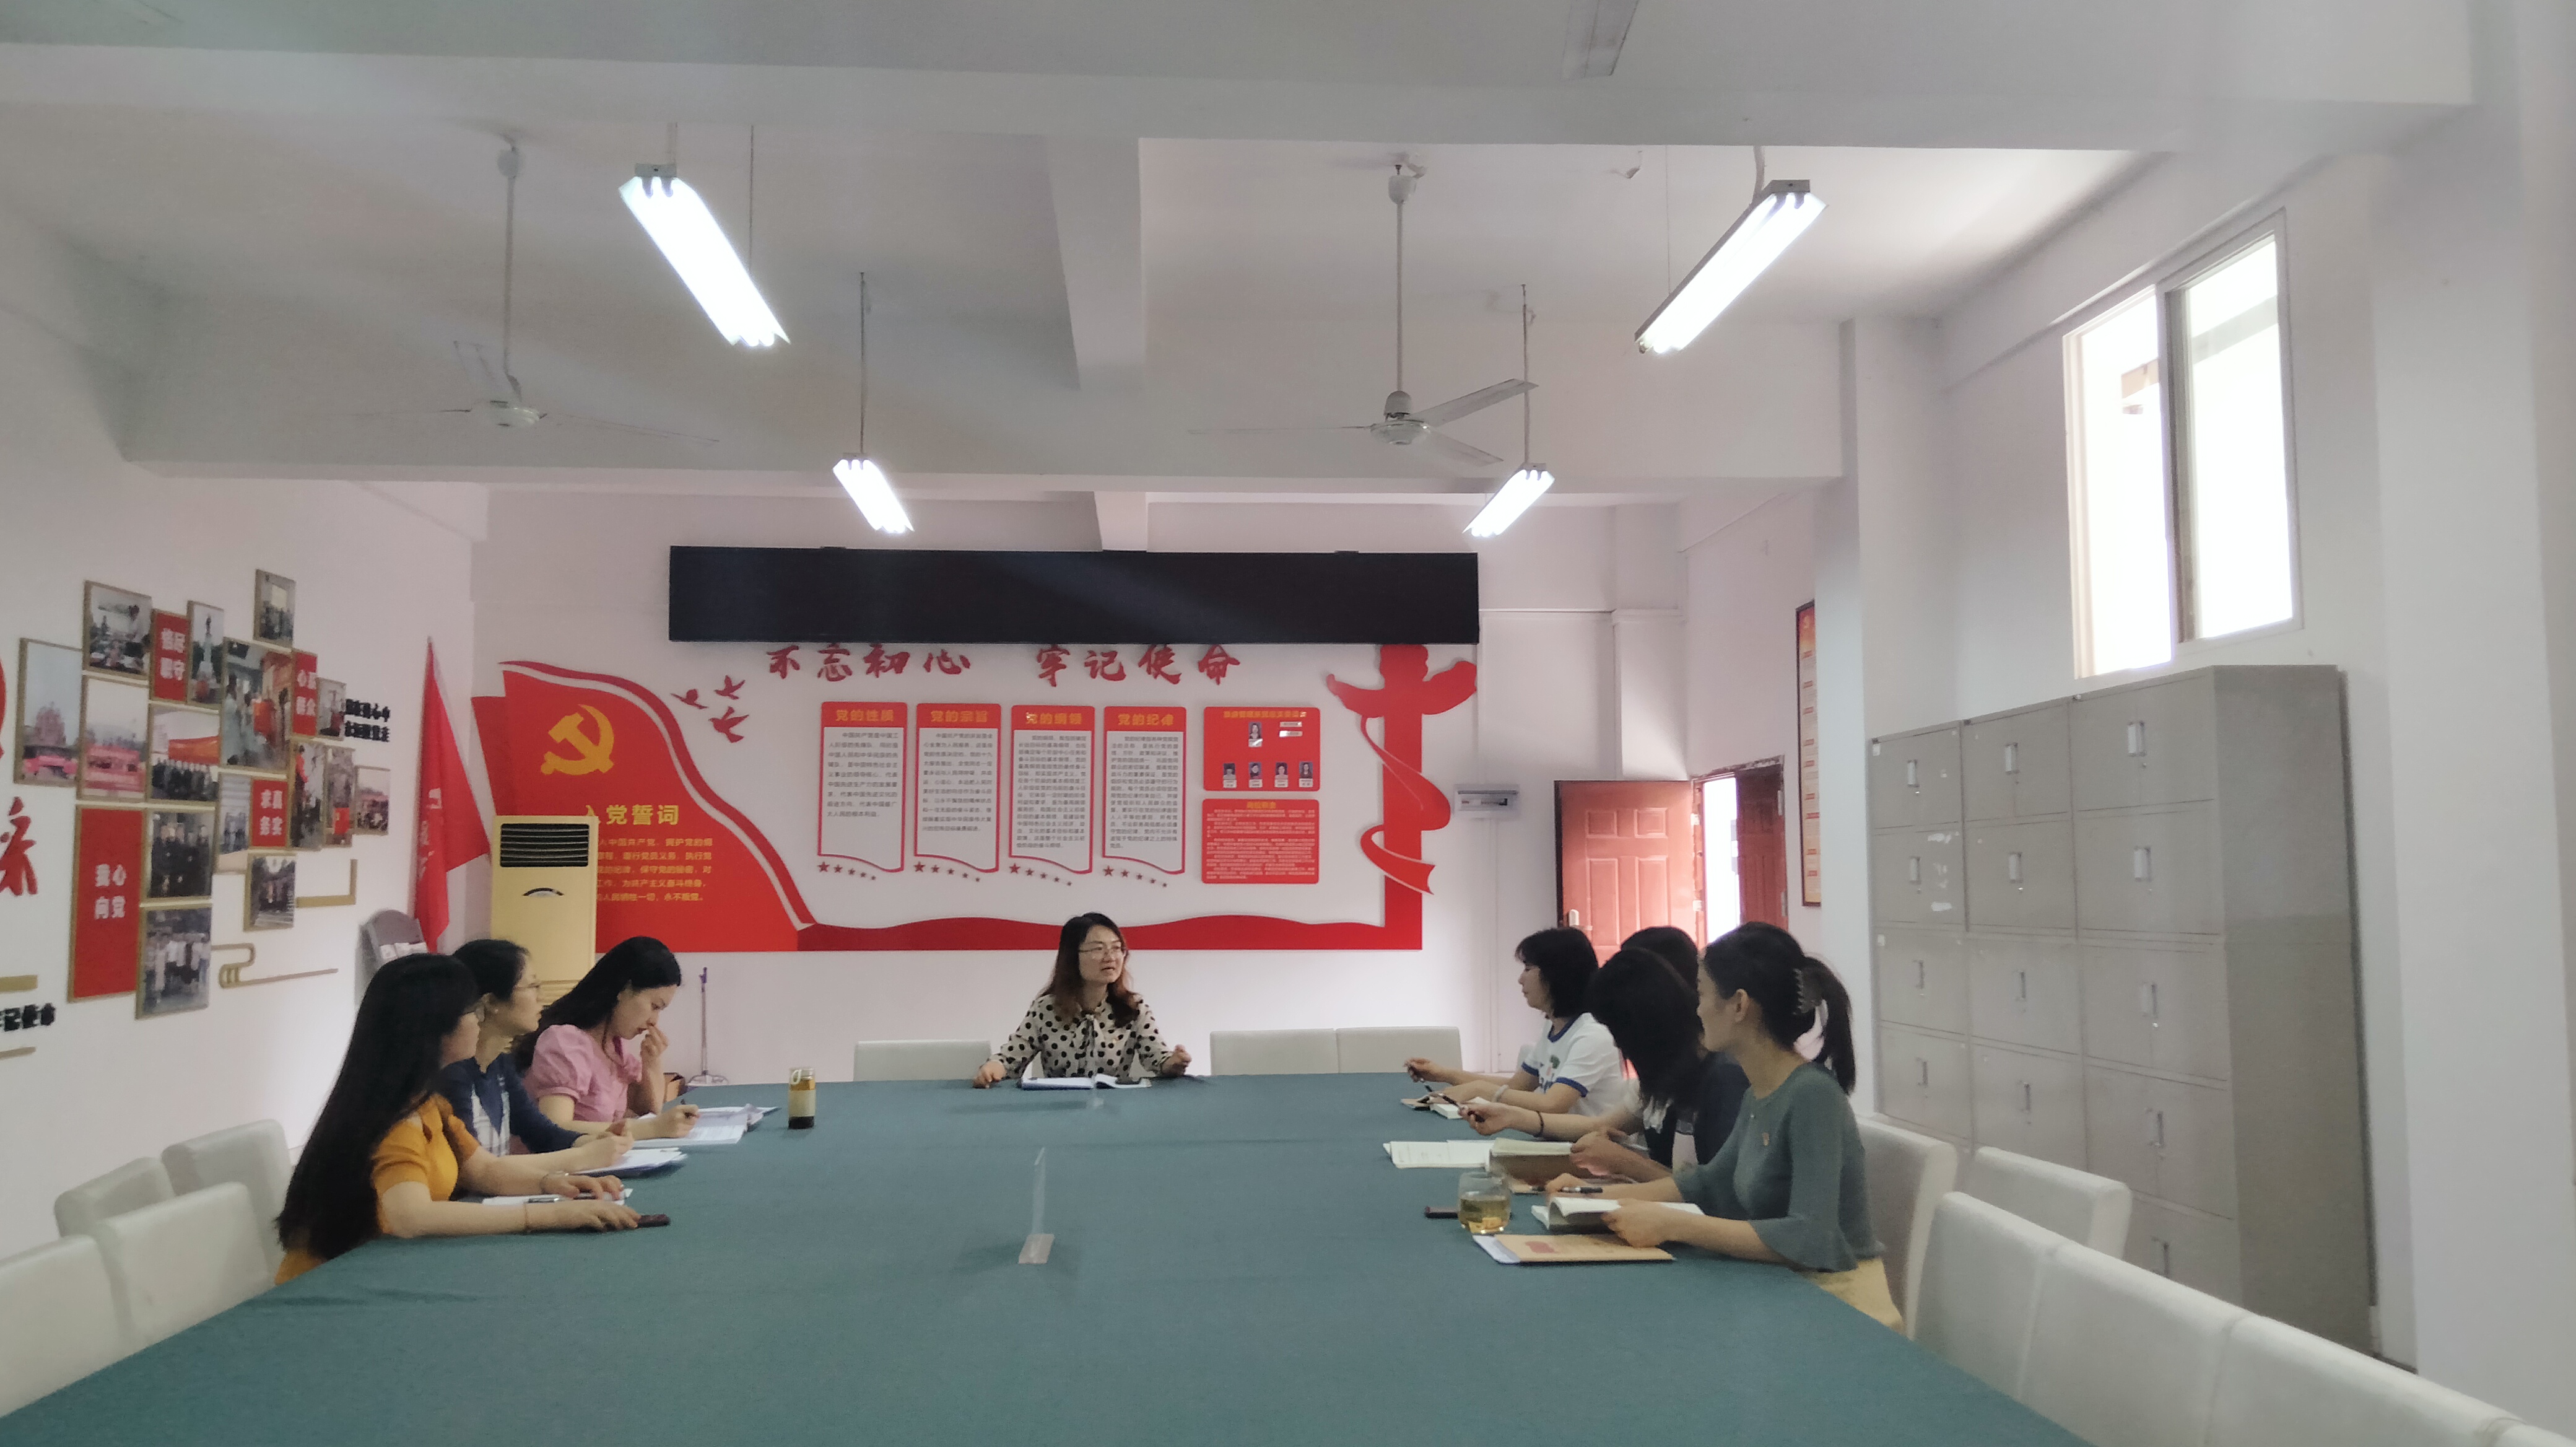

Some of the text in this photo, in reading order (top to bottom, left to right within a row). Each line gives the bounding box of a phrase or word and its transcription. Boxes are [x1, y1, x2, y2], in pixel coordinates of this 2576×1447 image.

[766, 642, 1240, 687] 不忘初心 牢记使命
[836, 709, 894, 722] 党的性质
[931, 710, 988, 723] 党的宗旨
[1025, 712, 1083, 725] 党的纲领
[1118, 714, 1175, 726] 党的纪律
[0, 1002, 56, 1032] 记使命
